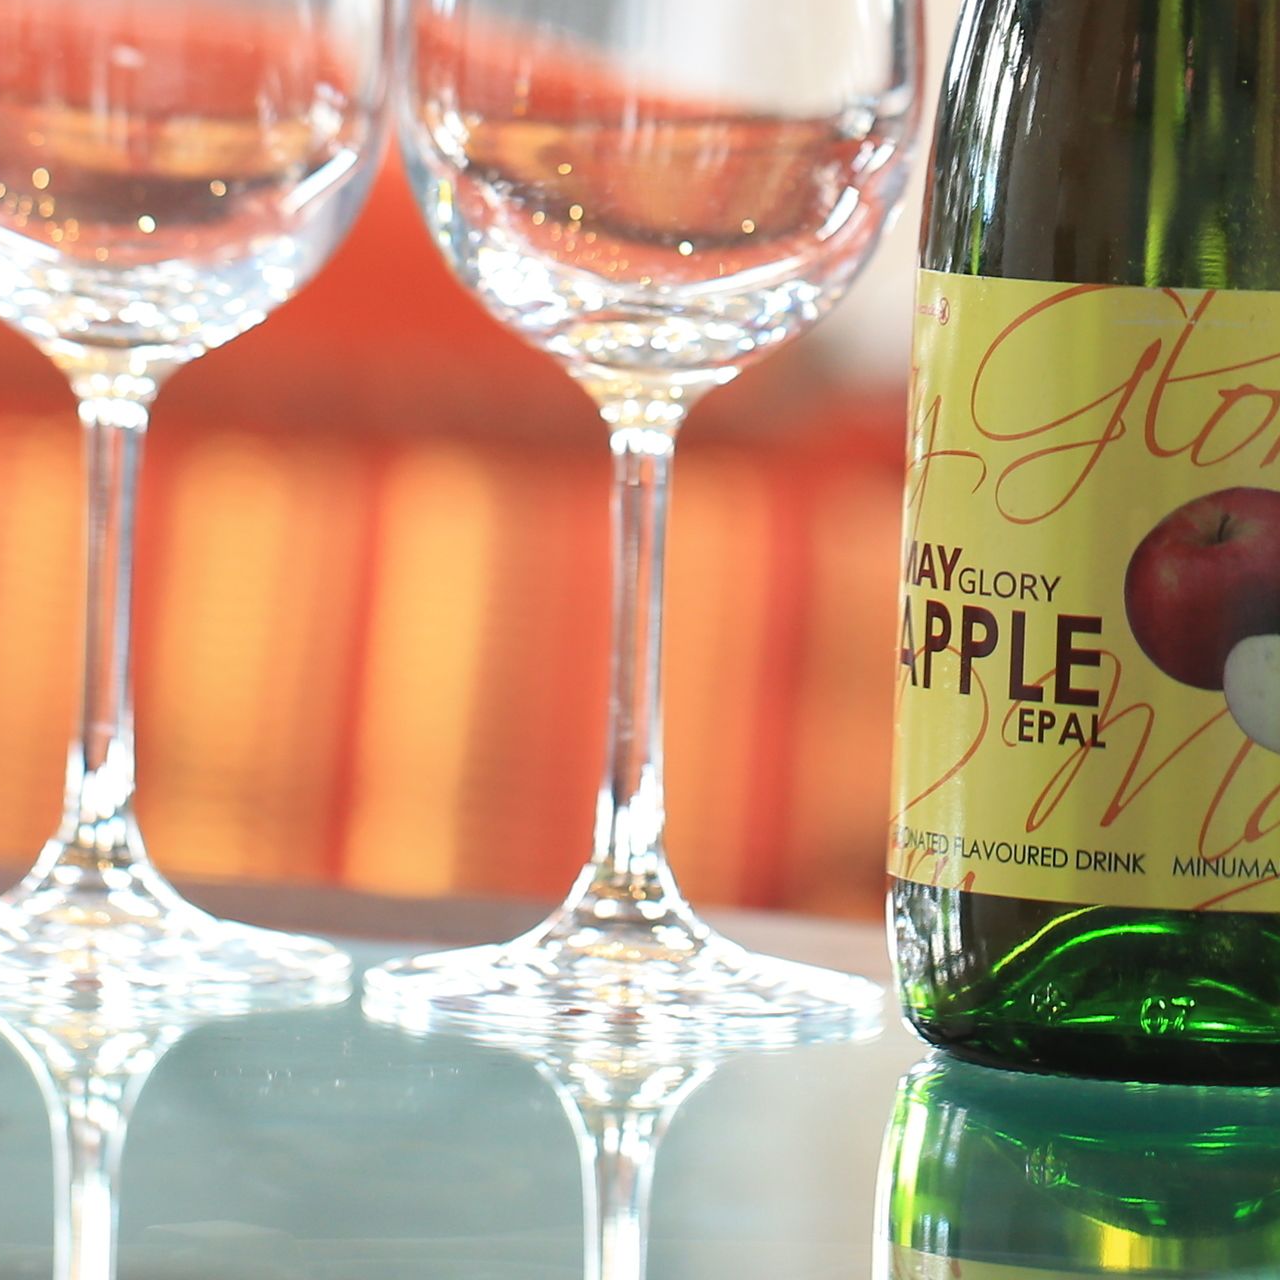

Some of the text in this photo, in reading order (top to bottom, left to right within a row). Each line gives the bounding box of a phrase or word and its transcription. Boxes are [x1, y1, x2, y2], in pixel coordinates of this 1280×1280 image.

[898, 594, 1103, 707] APPLE
[1018, 707, 1107, 749] EPAL
[953, 834, 1069, 869] FLAVOURED
[1075, 849, 1147, 875] DRINK
